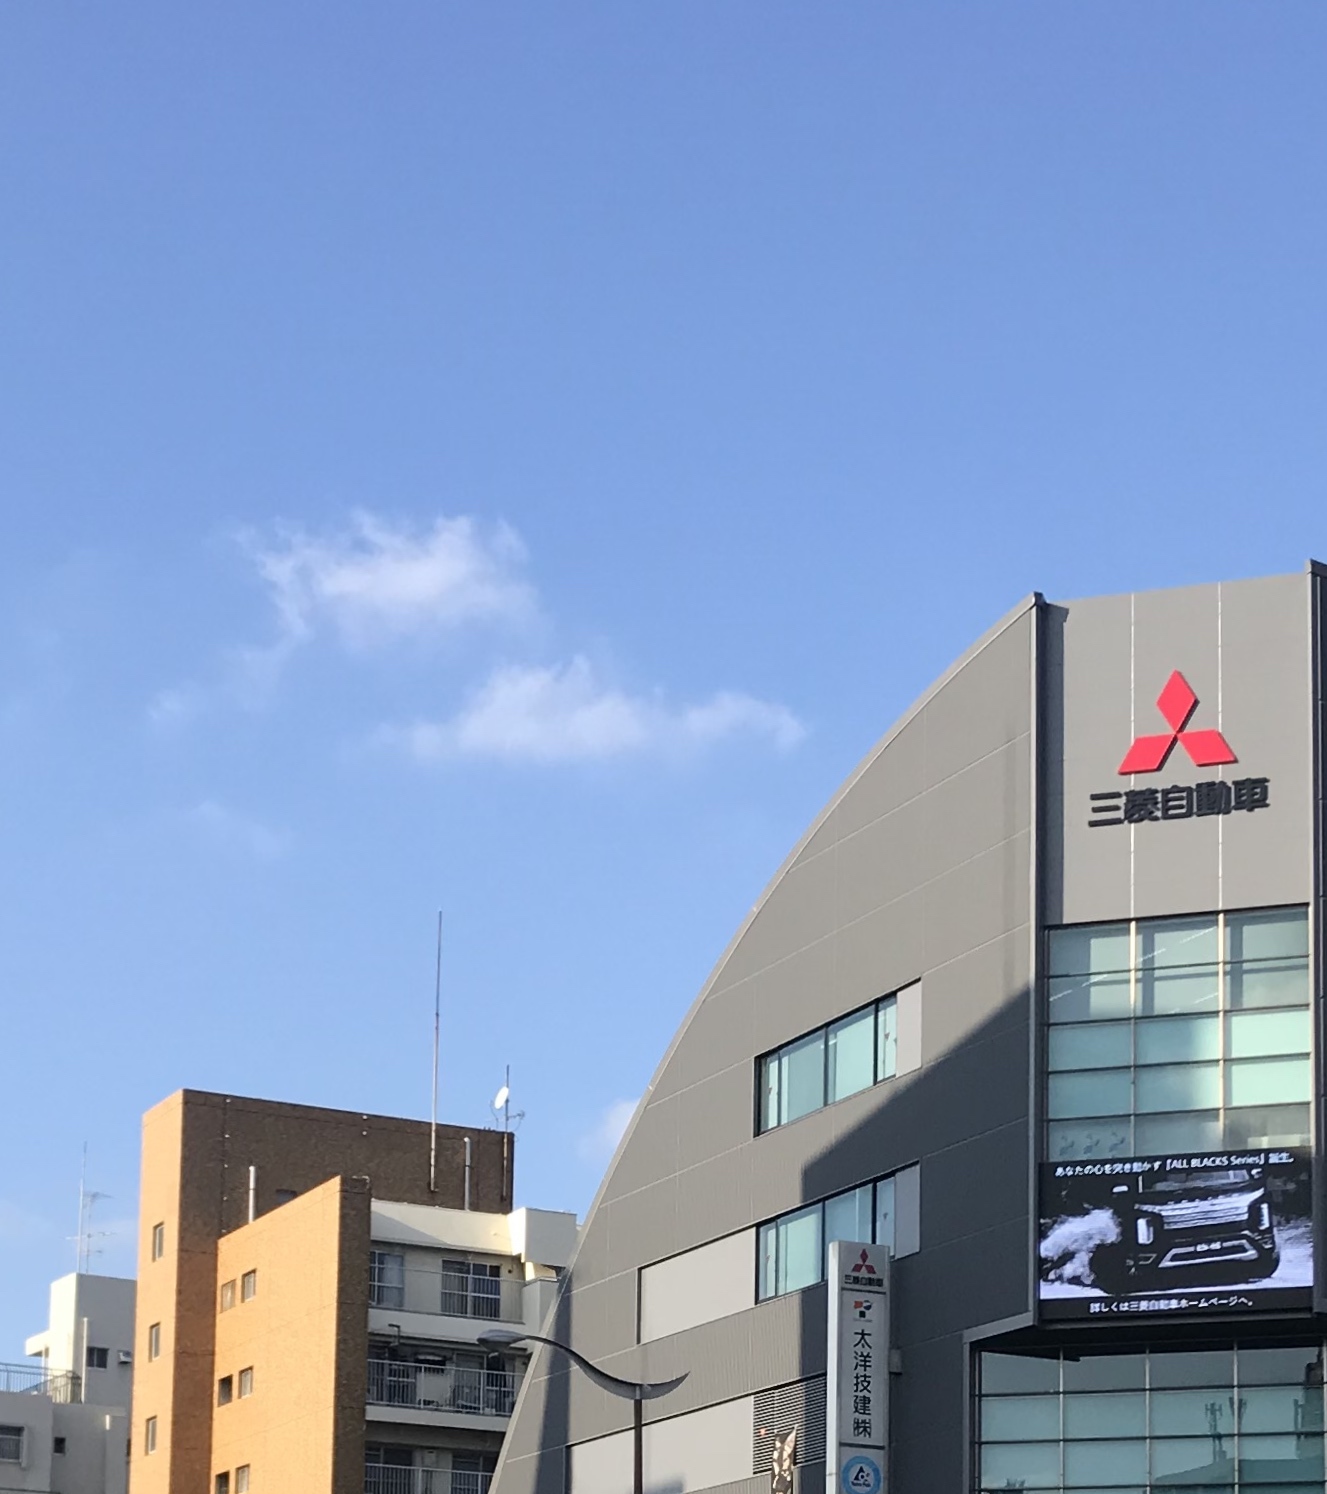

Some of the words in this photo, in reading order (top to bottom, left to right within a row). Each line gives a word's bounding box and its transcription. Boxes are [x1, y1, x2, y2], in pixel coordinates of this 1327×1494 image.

[1088, 777, 1270, 827] 三菱自動車
